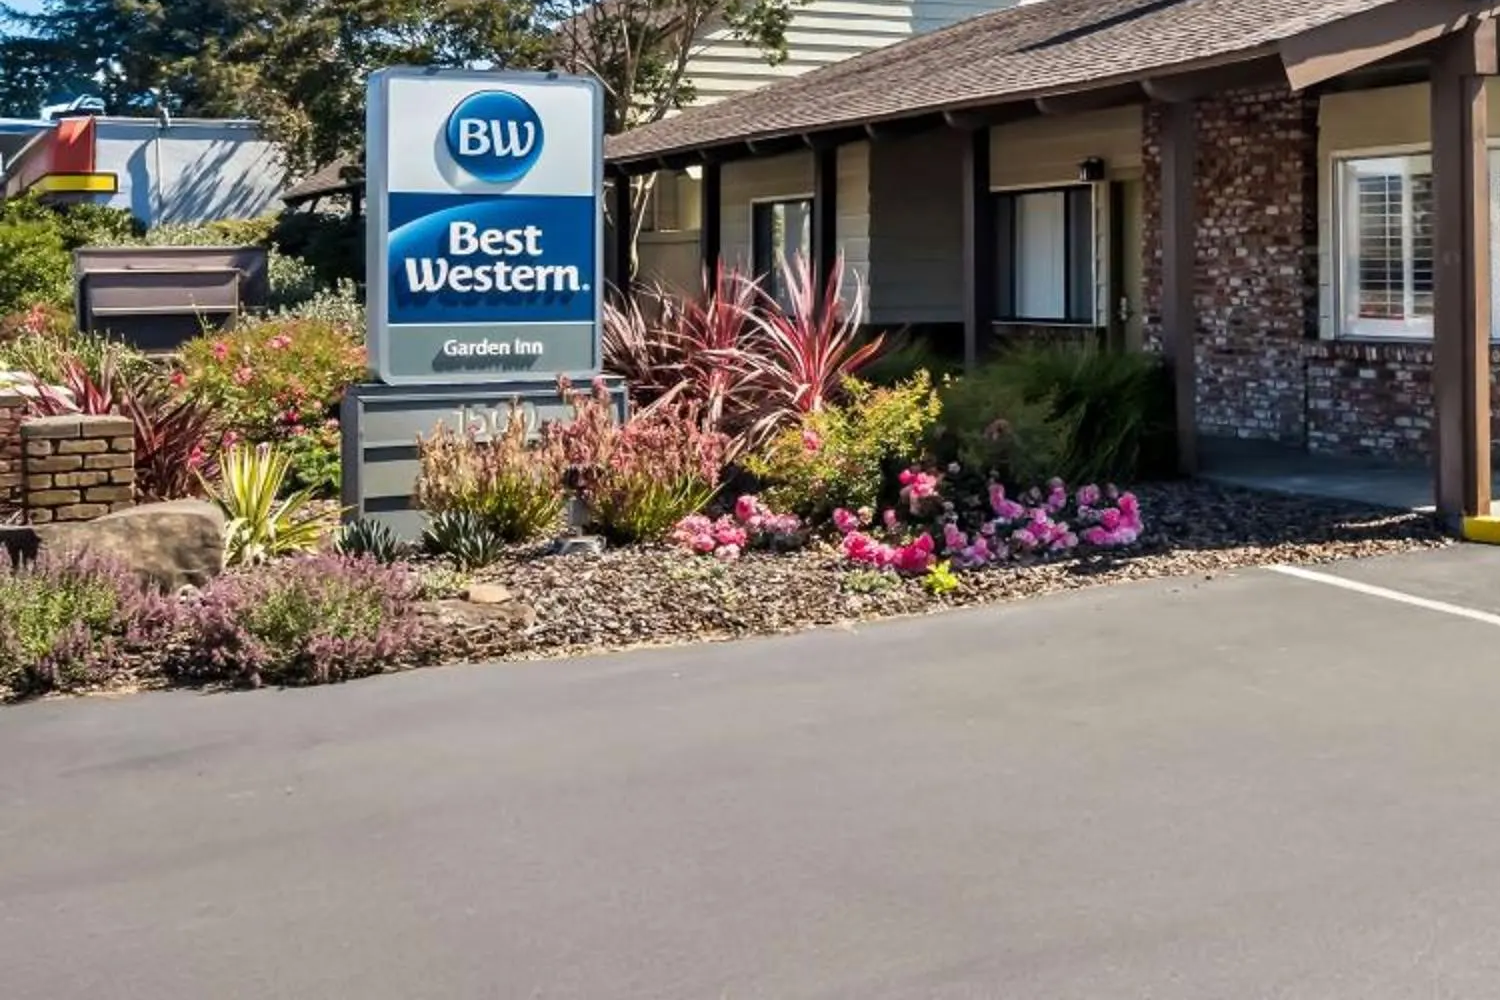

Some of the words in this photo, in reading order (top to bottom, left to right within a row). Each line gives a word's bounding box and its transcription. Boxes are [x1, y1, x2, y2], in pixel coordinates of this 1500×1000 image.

[459, 119, 535, 156] BW
[449, 221, 543, 256] Best
[443, 339, 511, 356] Garden
[514, 339, 543, 355] Inn
